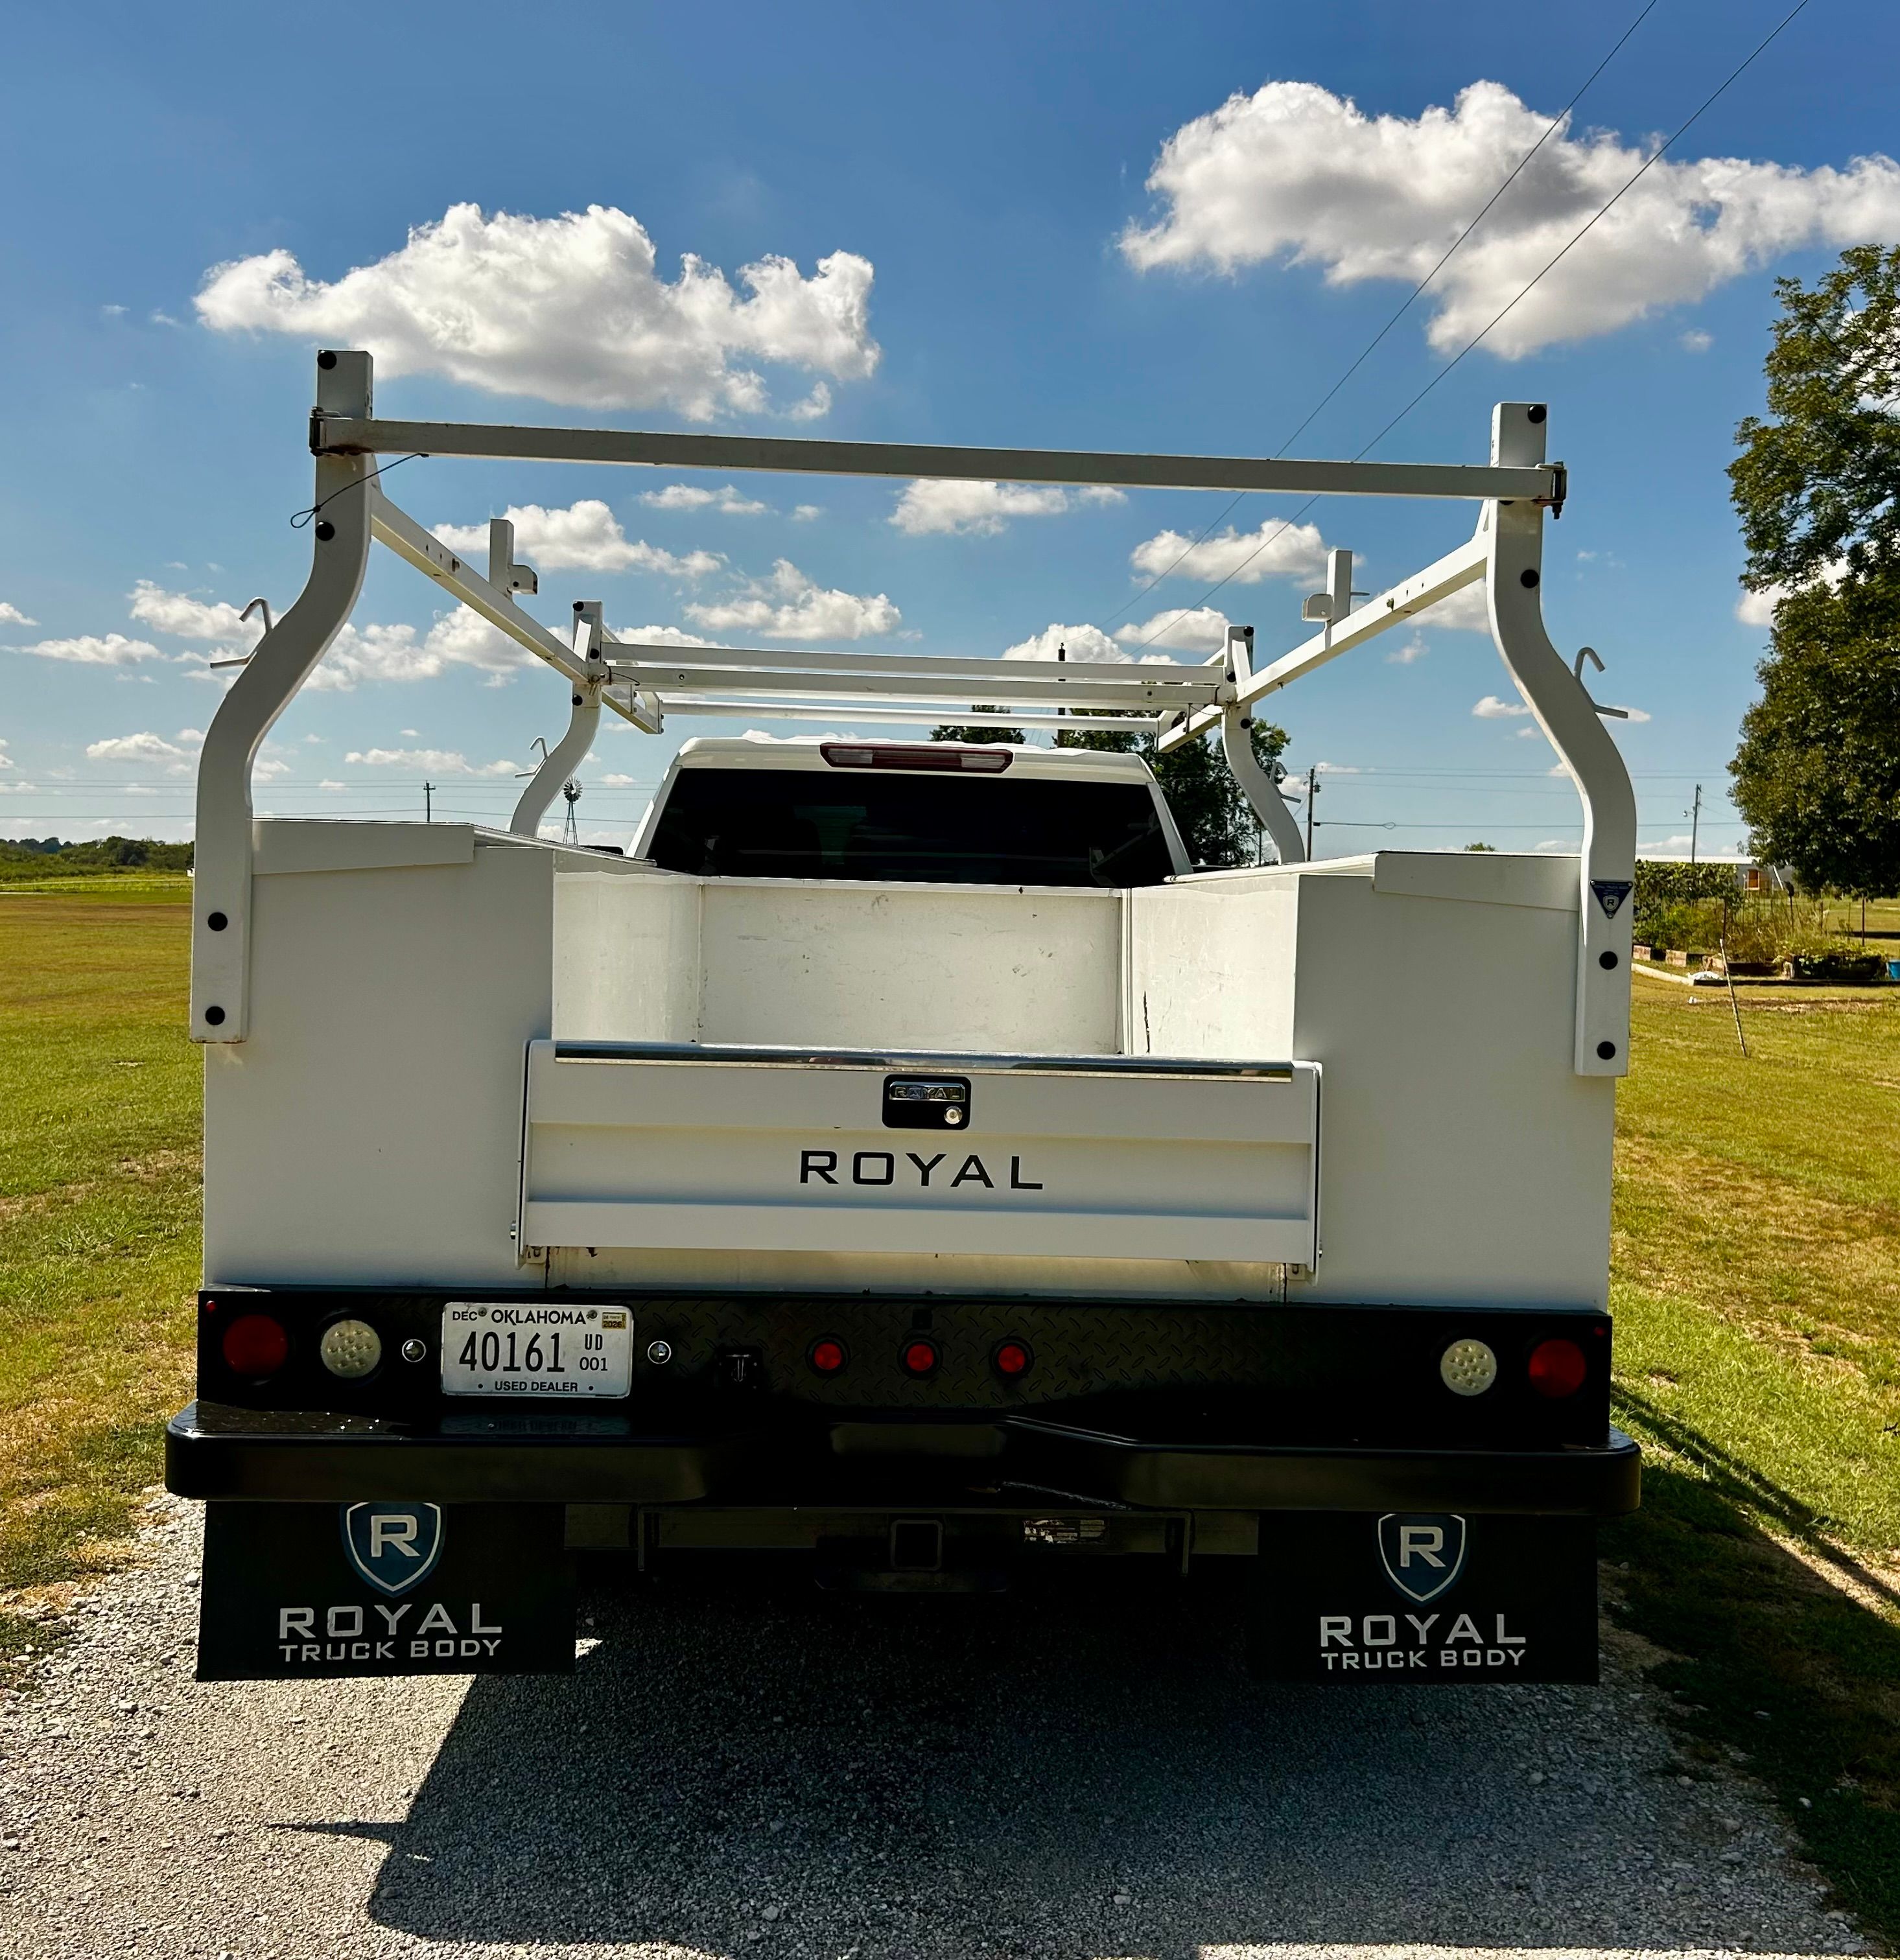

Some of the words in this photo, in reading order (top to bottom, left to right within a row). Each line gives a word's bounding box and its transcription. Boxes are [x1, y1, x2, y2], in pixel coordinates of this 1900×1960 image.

[895, 1086, 961, 1099] ROYAL
[800, 1150, 1044, 1190] ROYAL
[452, 1311, 478, 1322] DEC
[491, 1309, 586, 1326] OKLAHOMA
[602, 1320, 622, 1329] 2026
[459, 1331, 565, 1373] 40161
[584, 1333, 603, 1351] UD
[579, 1357, 608, 1371] 001
[494, 1381, 528, 1392] USED
[530, 1381, 578, 1392] DEALER
[371, 1514, 421, 1558] R
[1400, 1526, 1447, 1568] R
[279, 1603, 502, 1639] ROYAL
[1320, 1613, 1527, 1648] ROYAL
[278, 1641, 395, 1662] TRUCK
[410, 1639, 502, 1658] BODY
[1321, 1650, 1427, 1670] TRUCK
[1440, 1649, 1526, 1667] BODY
